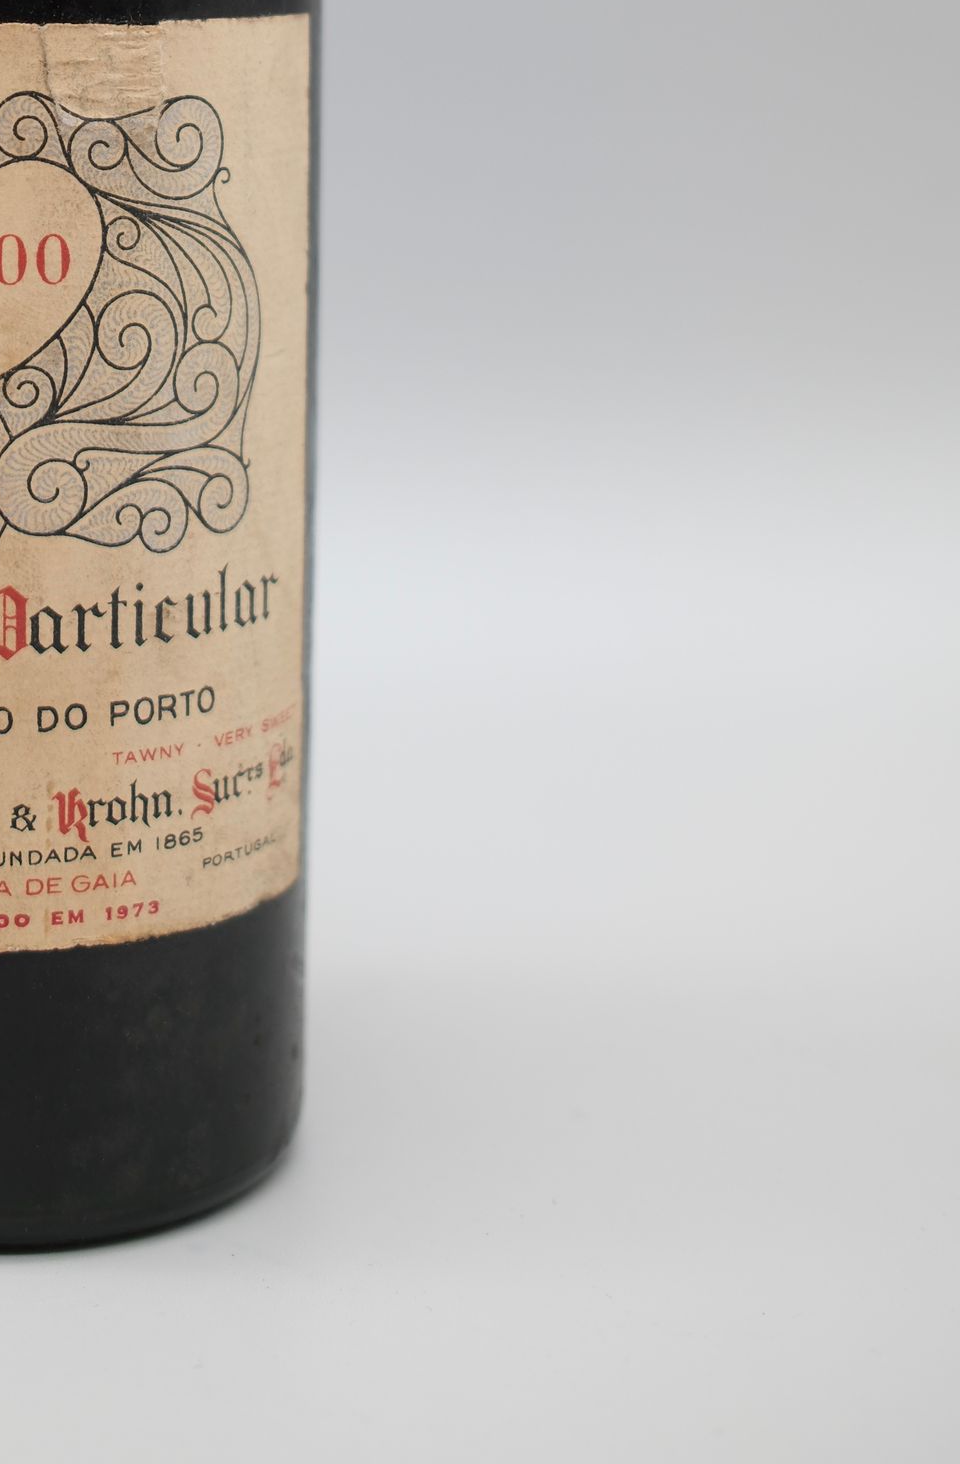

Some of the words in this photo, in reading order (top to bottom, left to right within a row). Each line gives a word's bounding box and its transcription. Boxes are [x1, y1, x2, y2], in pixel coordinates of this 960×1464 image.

[37, 703, 88, 733] DO
[110, 686, 215, 727] PORTO
[112, 743, 185, 766] TAWNY
[214, 726, 253, 747] VERY
[10, 802, 37, 832] &
[111, 839, 142, 858] EM
[155, 826, 204, 851] 1865
[25, 877, 63, 896] DE
[71, 870, 137, 894] GAIA
[51, 909, 85, 926] EM
[105, 899, 161, 922] 1973
